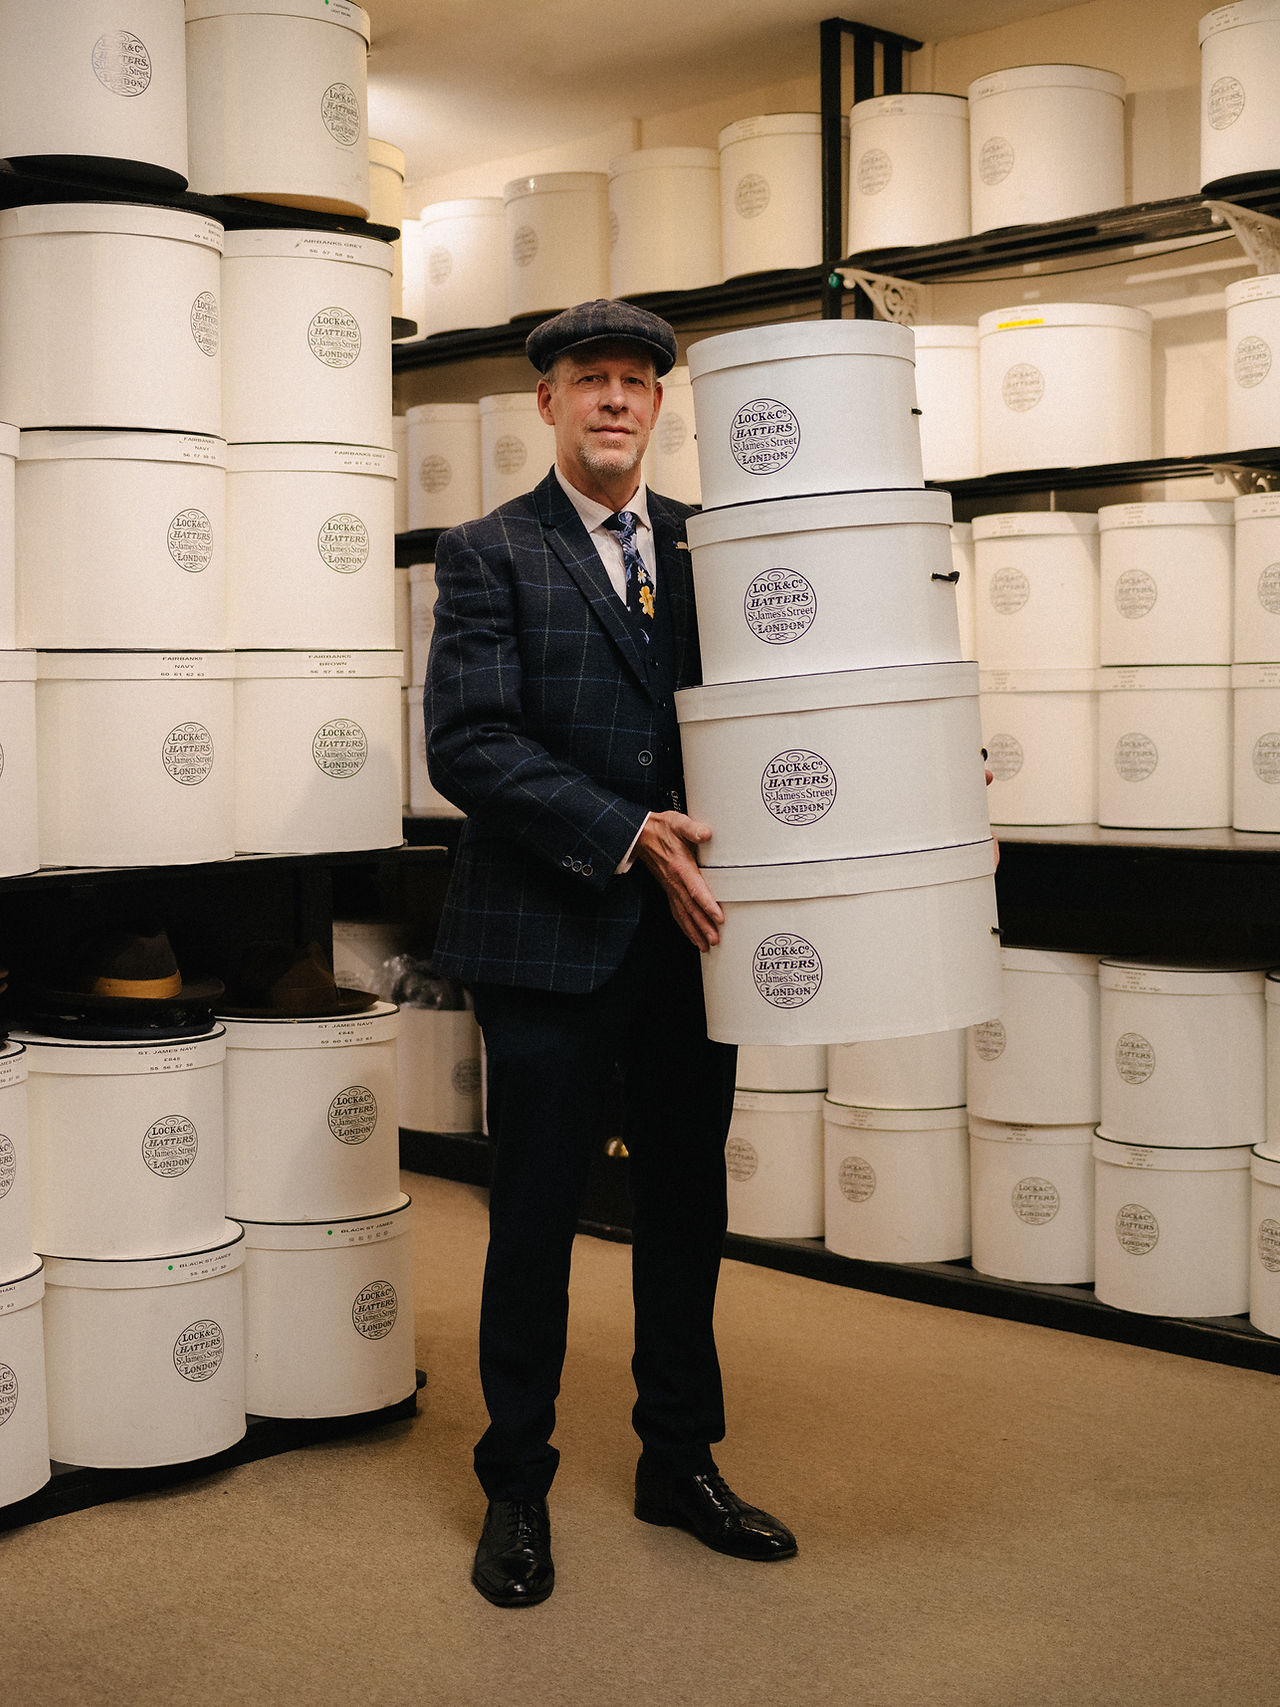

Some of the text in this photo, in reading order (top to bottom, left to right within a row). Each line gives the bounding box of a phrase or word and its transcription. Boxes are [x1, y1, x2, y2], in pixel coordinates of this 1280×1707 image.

[314, 328, 357, 338] HATTERS
[319, 350, 354, 359] LONDON
[736, 423, 792, 438] HATTERS
[771, 436, 796, 447] Street
[741, 451, 788, 464] LONDON
[174, 531, 210, 540] HATTERS
[177, 552, 208, 562] LONDON
[328, 556, 362, 564] LONDON
[751, 592, 808, 607] HATTERS
[787, 606, 813, 617] Street
[757, 621, 804, 634] LONDON
[173, 767, 206, 775] LONDON
[769, 775, 828, 788] HATTERS
[806, 788, 833, 798] Street
[775, 803, 824, 814] LONDON
[759, 960, 814, 970] HATTERS
[794, 972, 819, 982] Street
[765, 987, 811, 996] LONDON
[334, 1104, 374, 1116] HATTERS
[338, 1126, 370, 1136] LONDON
[149, 1134, 194, 1147] HATTERS
[153, 1158, 190, 1168] LONDON
[358, 1298, 394, 1312] HATTERS
[362, 1320, 392, 1332] LONDON
[180, 1336, 220, 1354] HATTERS
[184, 1360, 218, 1374] LONDON
